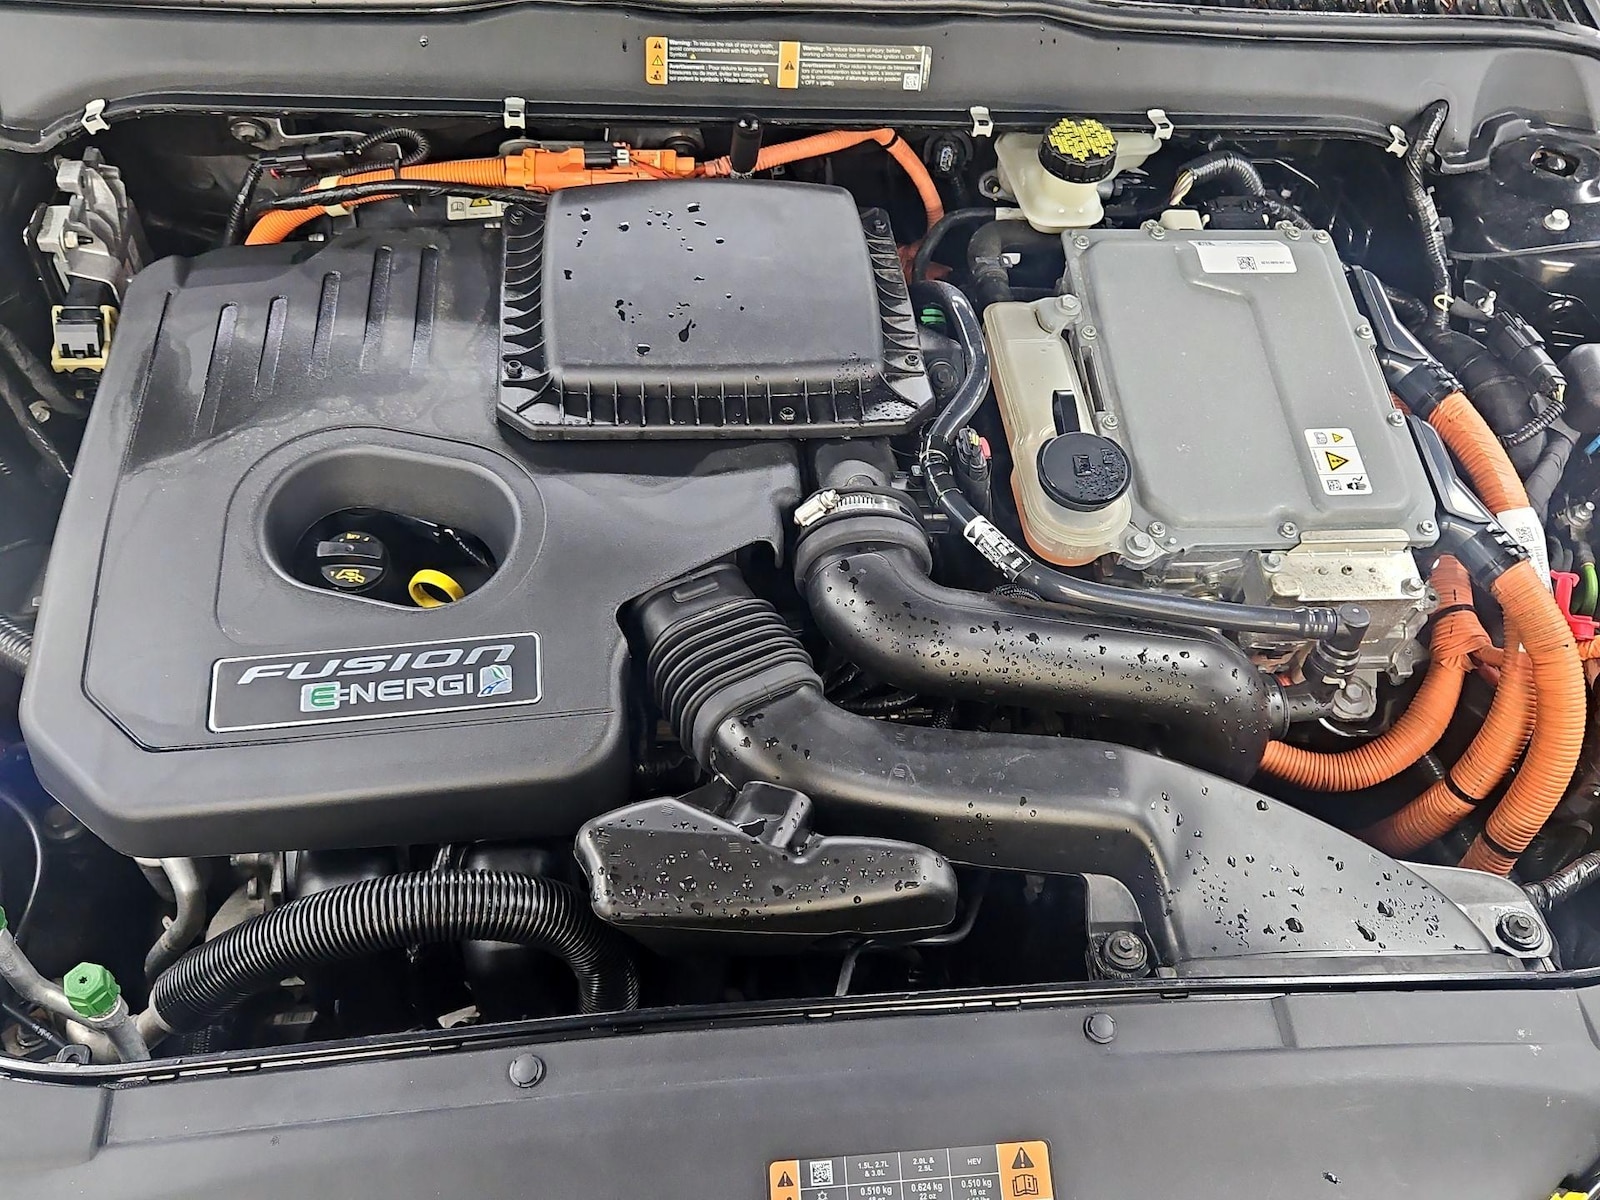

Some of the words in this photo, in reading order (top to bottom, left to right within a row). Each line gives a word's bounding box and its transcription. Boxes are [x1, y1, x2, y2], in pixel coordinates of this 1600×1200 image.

[237, 643, 515, 685] FUSION
[874, 1160, 890, 1168] 2.7L
[967, 1158, 982, 1166] HEV
[918, 1164, 933, 1172] 2.5L
[911, 1182, 932, 1192] 0.624
[932, 1182, 943, 1192] kg
[961, 1178, 981, 1188] 0.510
[982, 1178, 992, 1188] kg
[860, 1186, 880, 1196] 0.510
[882, 1185, 892, 1196] kg
